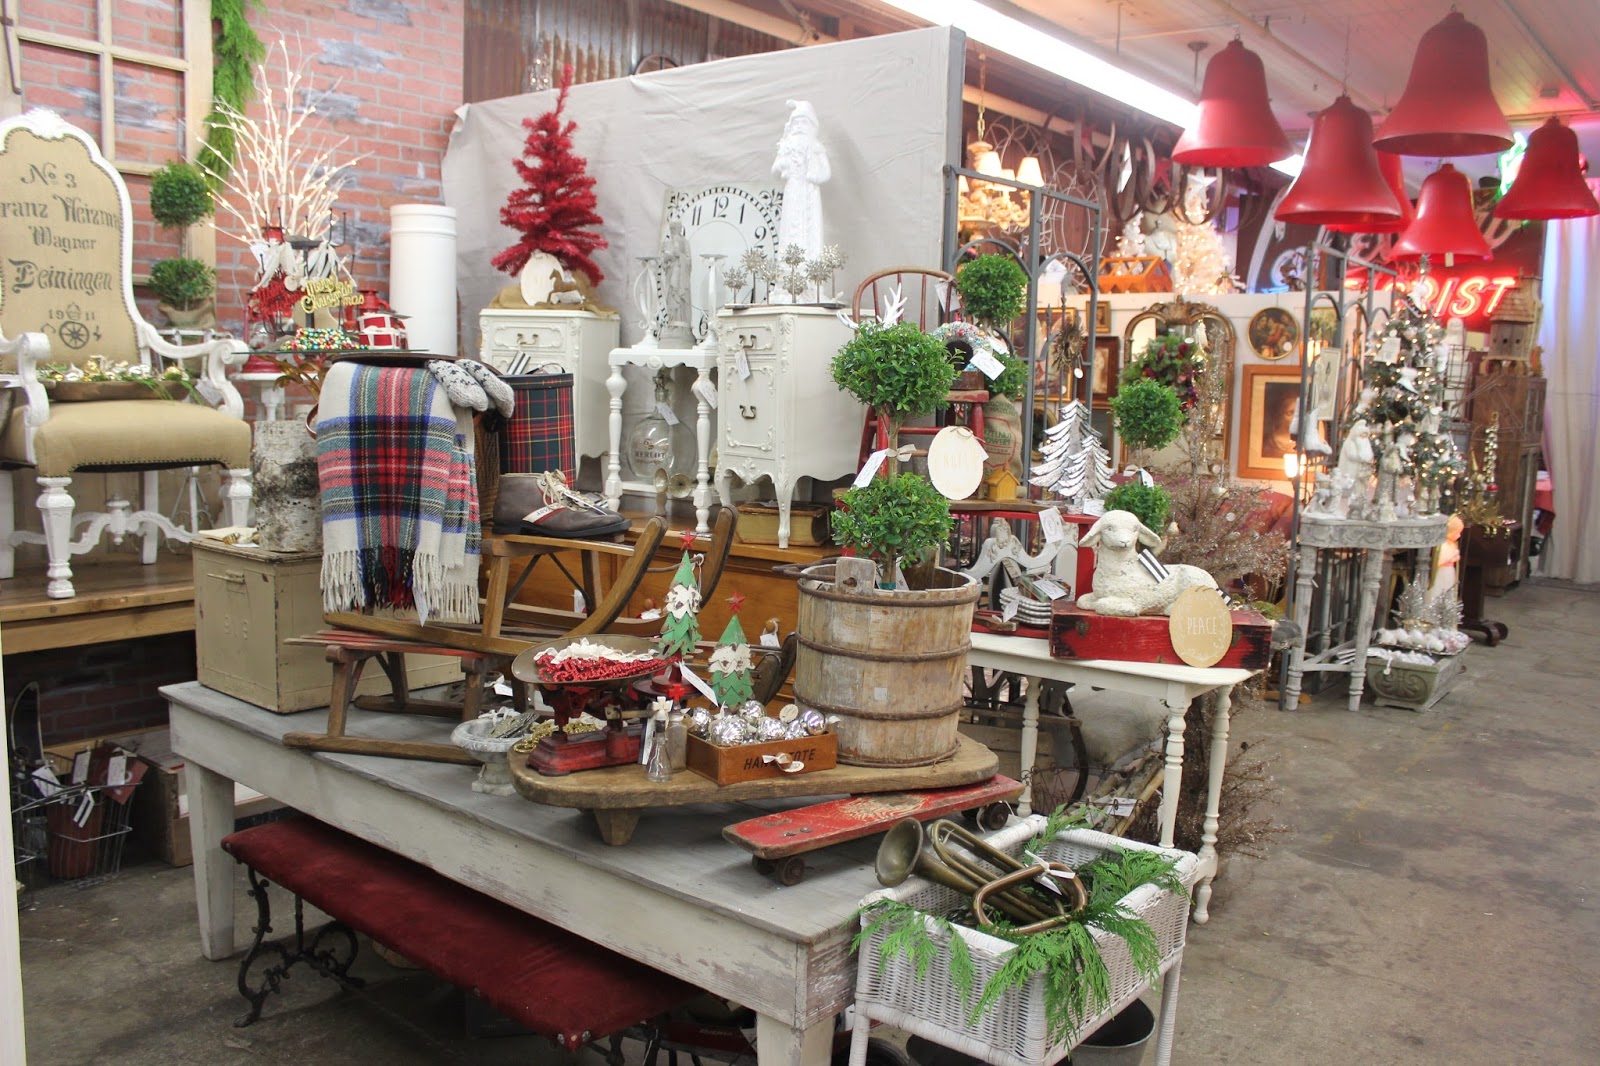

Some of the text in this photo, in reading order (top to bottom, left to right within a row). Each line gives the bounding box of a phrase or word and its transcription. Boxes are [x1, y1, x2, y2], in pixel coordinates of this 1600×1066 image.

[64, 173, 77, 189] 3
[691, 204, 702, 226] 11
[713, 196, 729, 218] 12
[754, 226, 767, 248] 2
[48, 308, 65, 320] 19
[1187, 616, 1217, 635] PEACE
